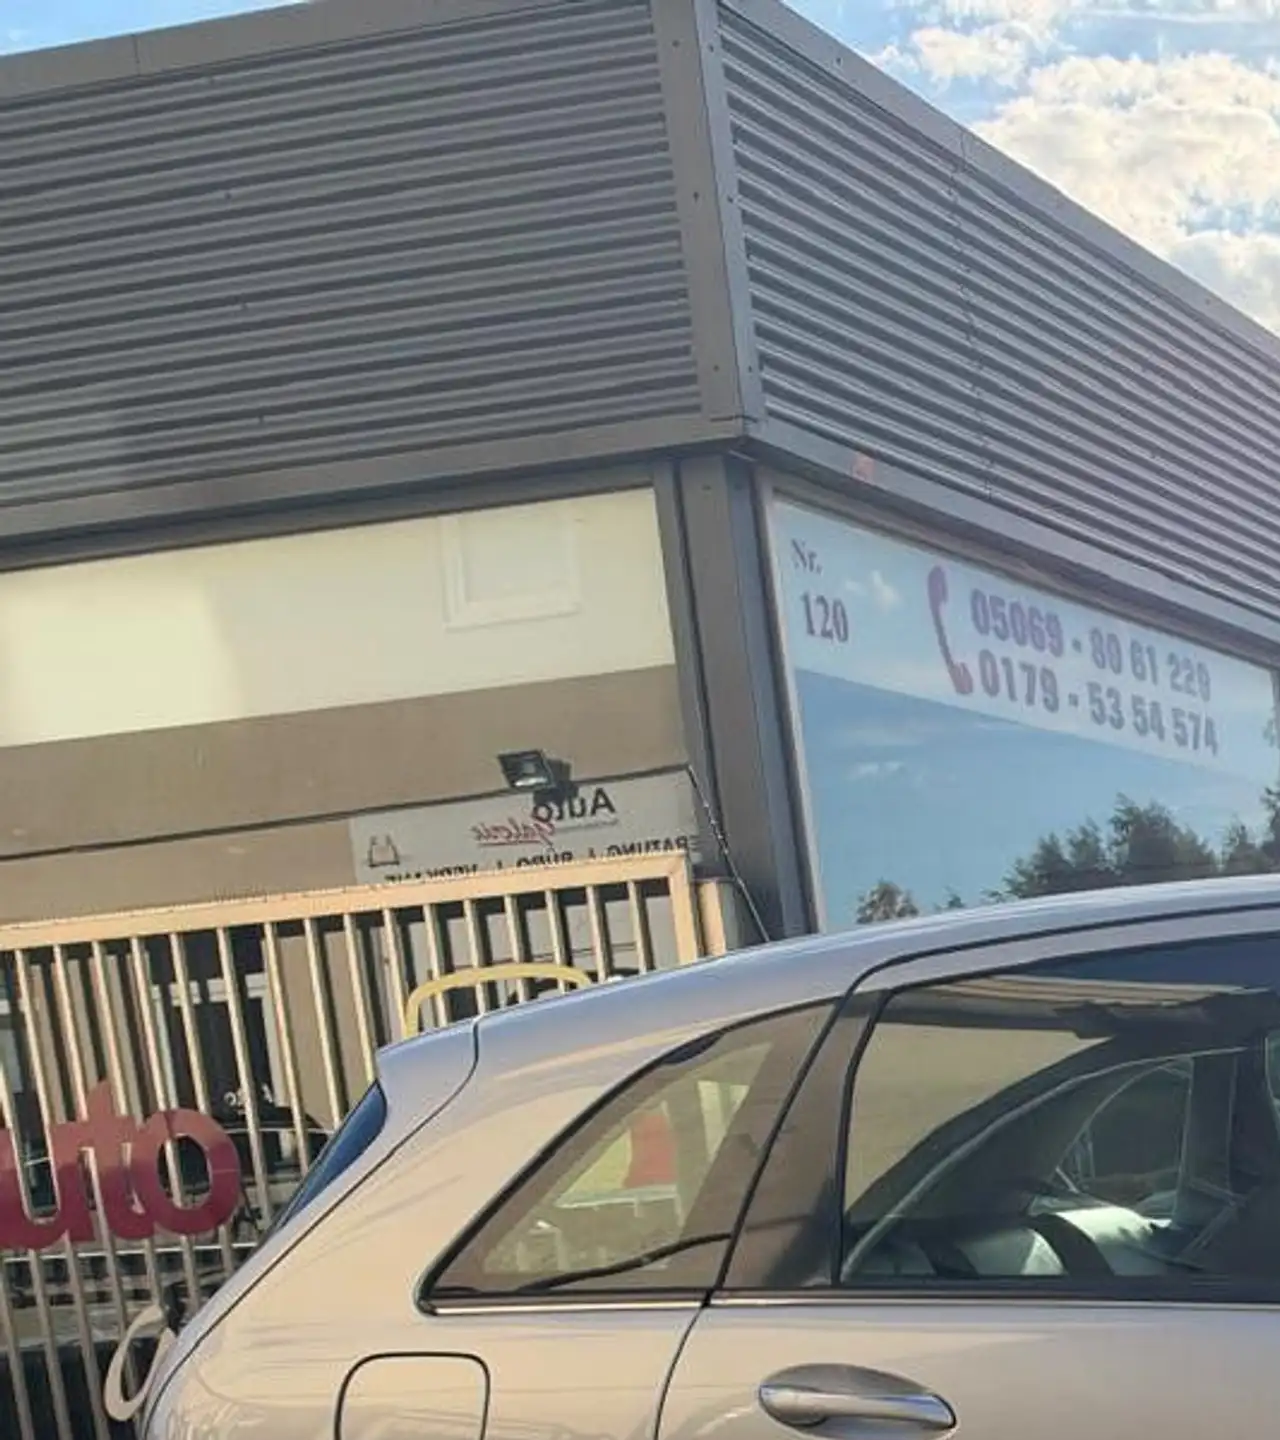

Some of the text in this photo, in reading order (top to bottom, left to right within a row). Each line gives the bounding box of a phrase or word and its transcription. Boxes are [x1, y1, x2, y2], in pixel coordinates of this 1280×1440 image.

[790, 538, 823, 574] Nr.
[800, 592, 849, 643] 120
[971, 588, 1064, 658] 05069
[978, 649, 1060, 713] 0179
[1086, 681, 1125, 730] 53
[1130, 694, 1166, 741] 54
[1171, 707, 1219, 757] 574
[0, 1080, 241, 1251] uto
